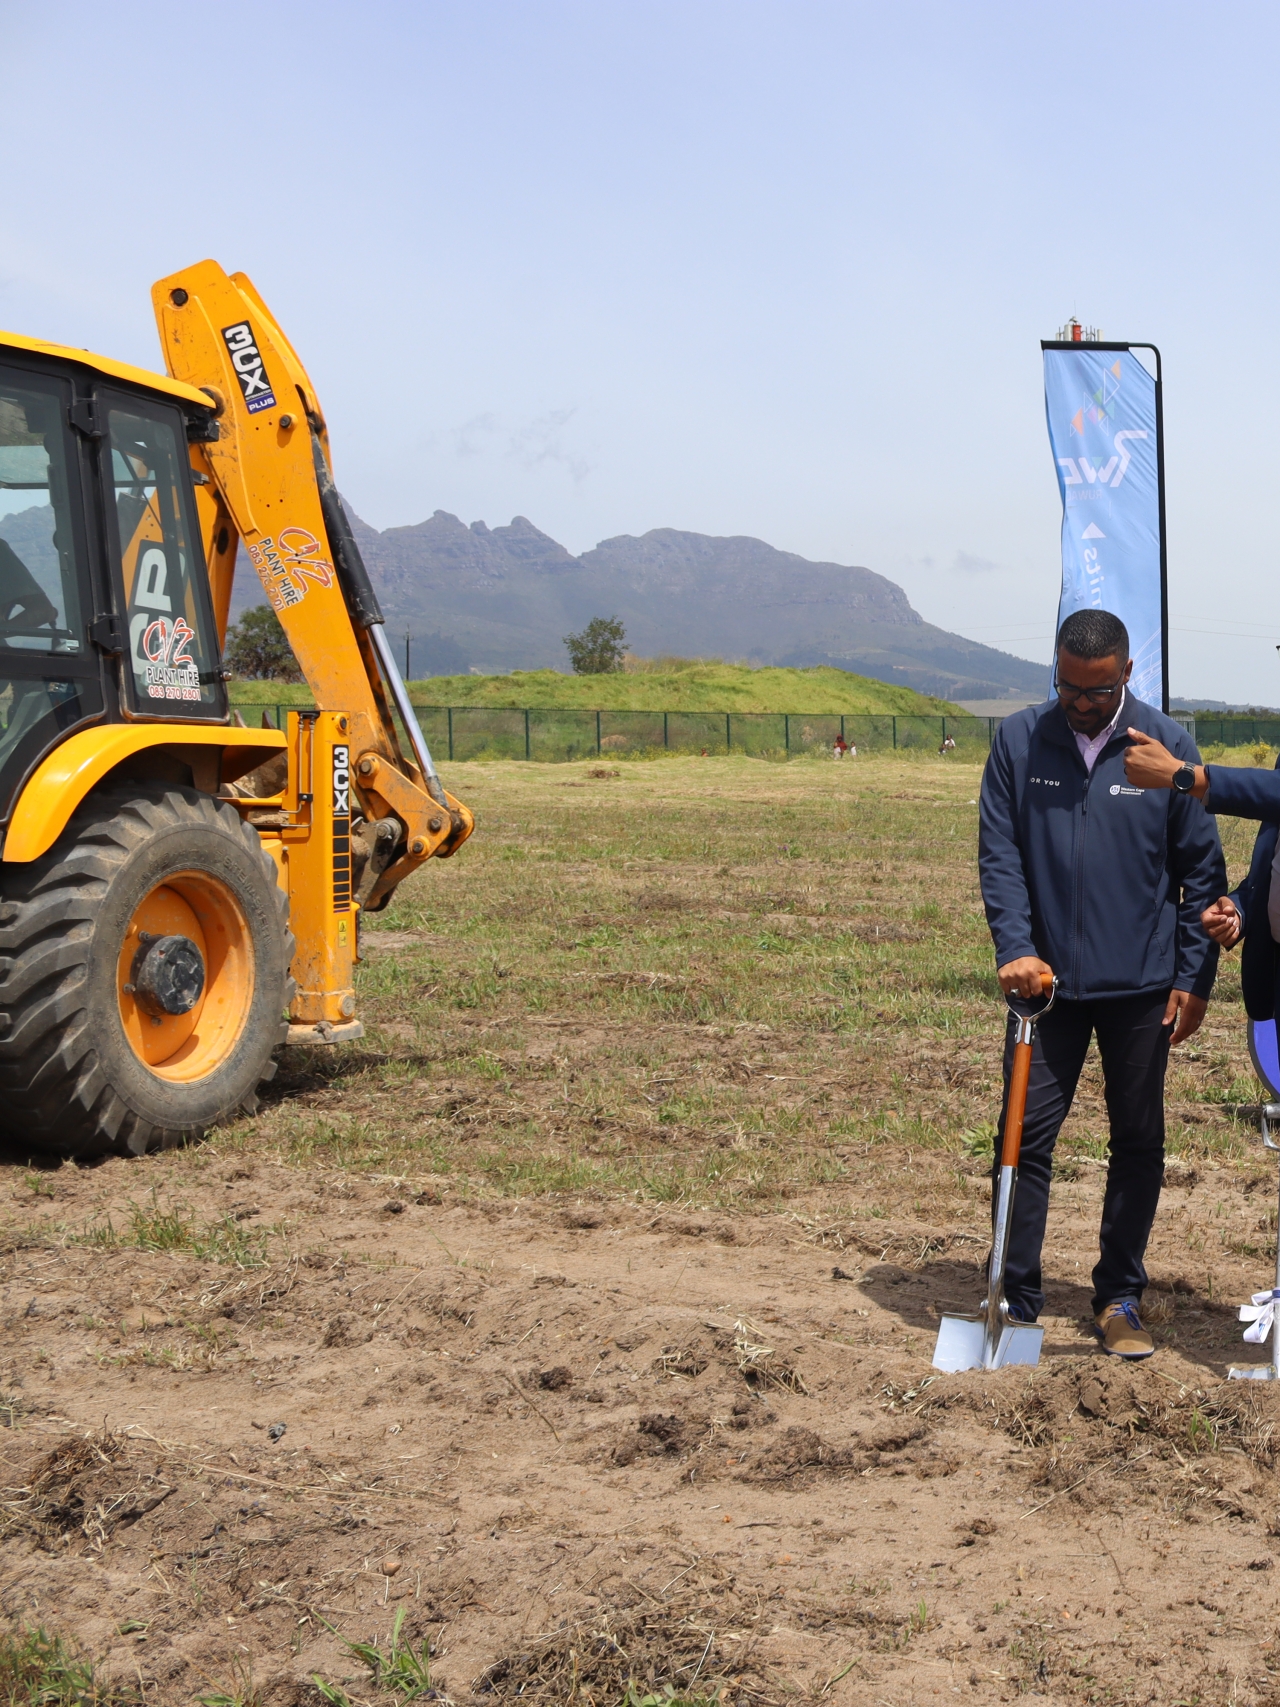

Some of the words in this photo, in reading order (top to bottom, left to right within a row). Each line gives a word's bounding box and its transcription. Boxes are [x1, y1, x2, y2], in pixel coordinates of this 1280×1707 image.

[225, 325, 270, 396] 3CX
[249, 398, 274, 411] PLUS
[249, 546, 263, 565] 083
[269, 588, 285, 611] 201
[260, 538, 285, 576] PLANT
[280, 577, 299, 606] HIRE
[147, 667, 176, 684] PLANT
[178, 669, 199, 687] HIRE
[149, 685, 164, 698] 083
[165, 687, 181, 699] 270
[182, 688, 201, 701] 2801
[334, 748, 348, 811] 3CX
[1044, 779, 1060, 787] YOU
